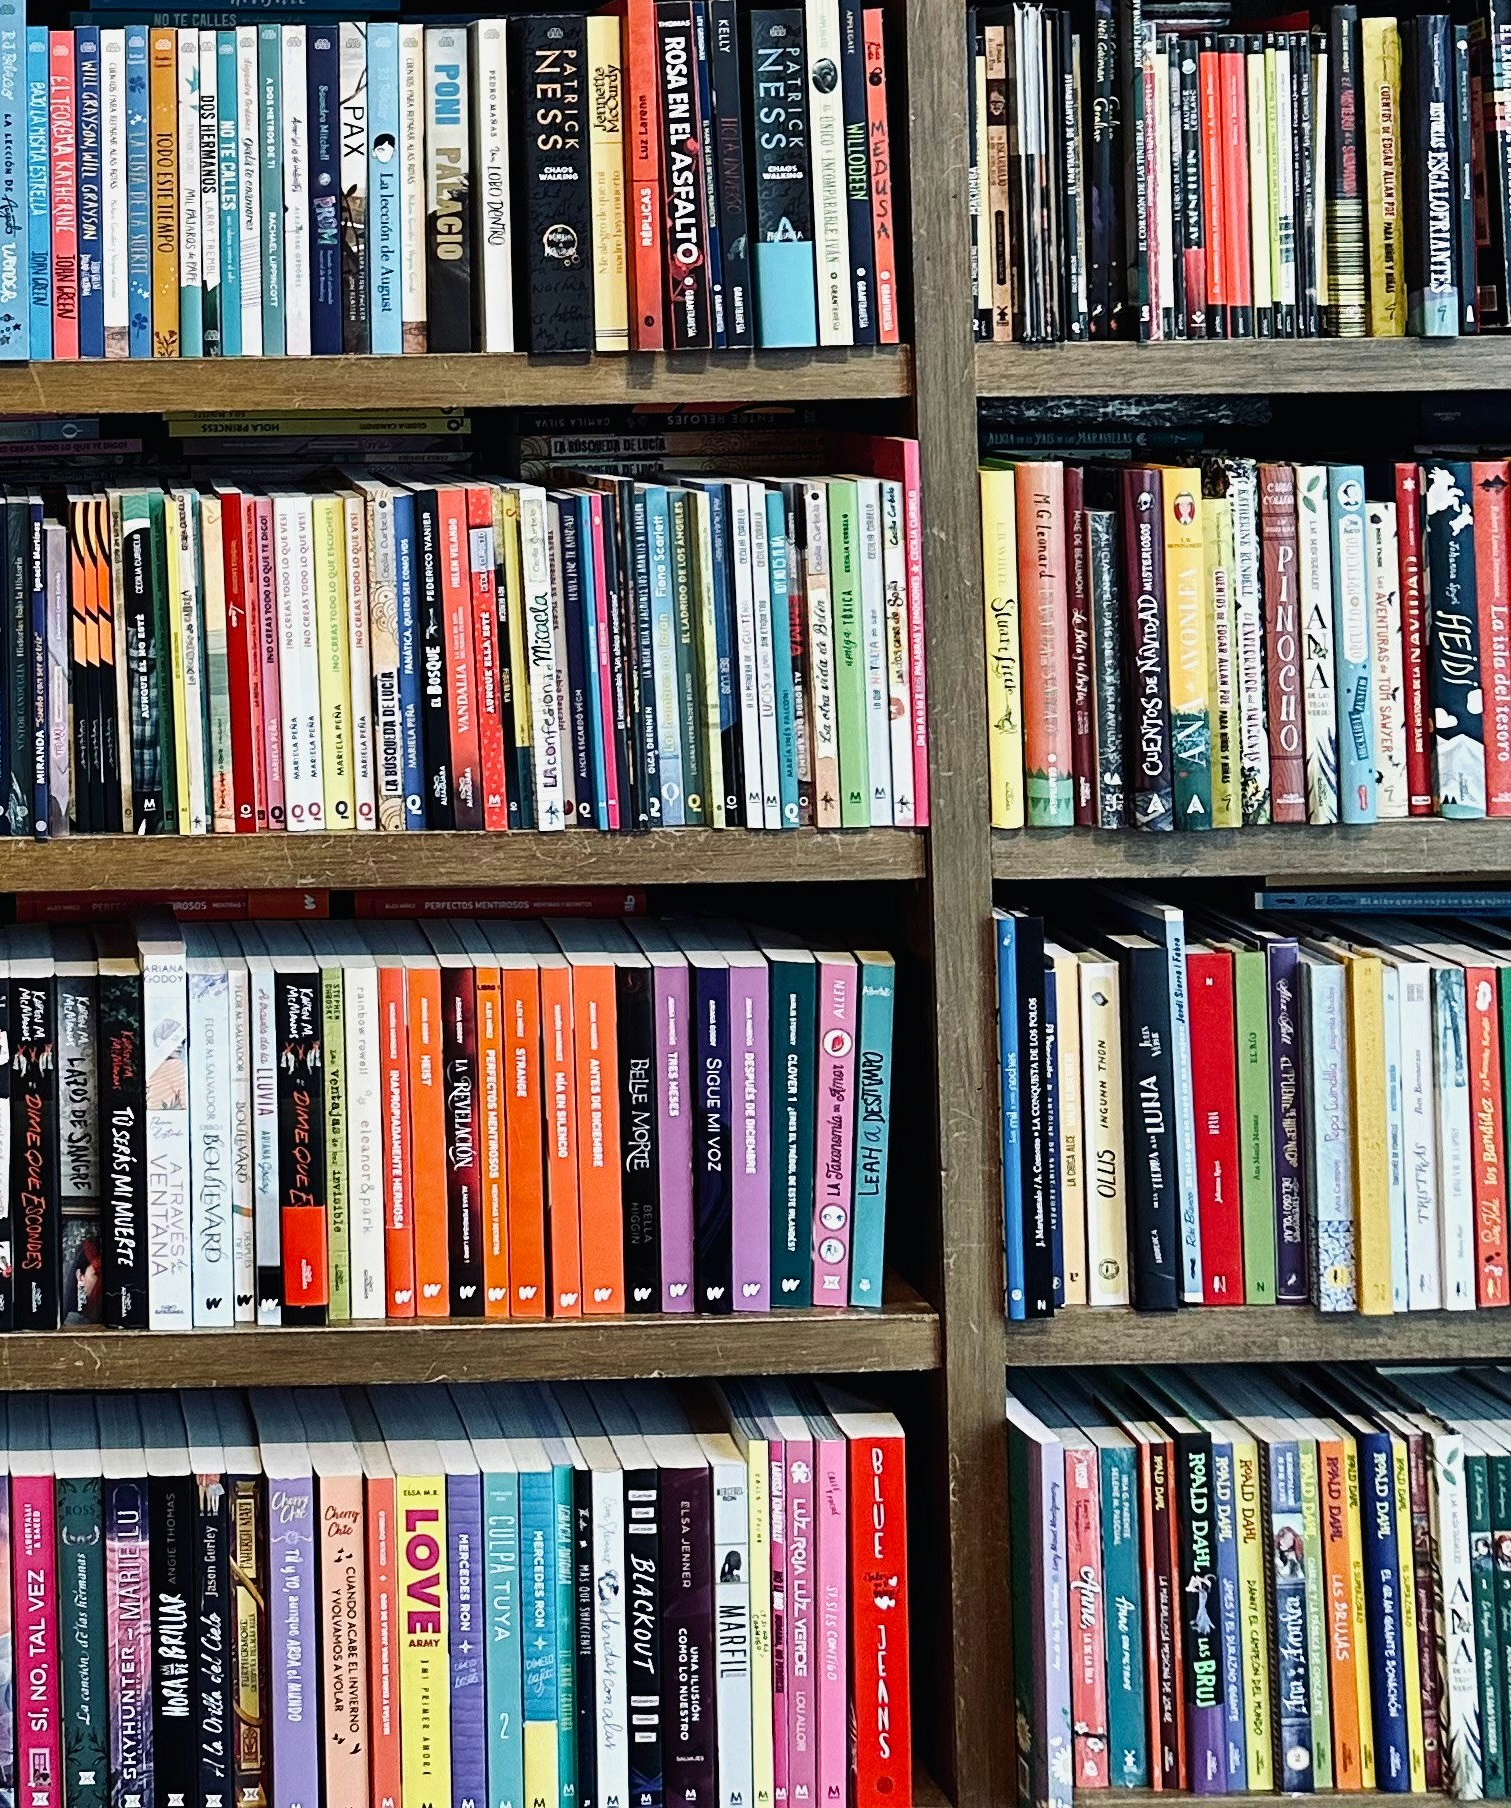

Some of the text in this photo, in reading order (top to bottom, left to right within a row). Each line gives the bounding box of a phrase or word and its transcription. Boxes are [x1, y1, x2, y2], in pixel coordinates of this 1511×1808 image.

[201, 95, 216, 194] DOS HERMANOS
[343, 105, 365, 158] PAX
[435, 63, 460, 125] PONI
[535, 50, 563, 152] NESS
[563, 49, 579, 150] PATRICK
[664, 36, 700, 265] ROSA EN EL ASFALTO
[220, 120, 236, 212] NO TE CALLES
[436, 148, 464, 261] PALACIO
[870, 120, 891, 240] MEDUSA
[1136, 523, 1164, 777] CUENTOS DE NAVIDAD MISTERIOSOS
[1275, 545, 1298, 752] PINOCHO
[1440, 610, 1478, 687] HEIDI
[706, 1057, 721, 1173] SIGUE MI VOZ
[1096, 1040, 1116, 1200] OLLIS INGUNN THON
[1139, 1075, 1165, 1134] LUNA
[1189, 1452, 1211, 1573] ROALD DAHL
[405, 1509, 442, 1635] LOVE
[632, 1553, 655, 1676] BLACKOUT
[869, 1447, 891, 1760] BLUE JEANS
[27, 1569, 49, 1733] SÍ, NO, TAL VEZ
[408, 1637, 441, 1648] ARMY
[719, 1604, 746, 1677] MARFIL
